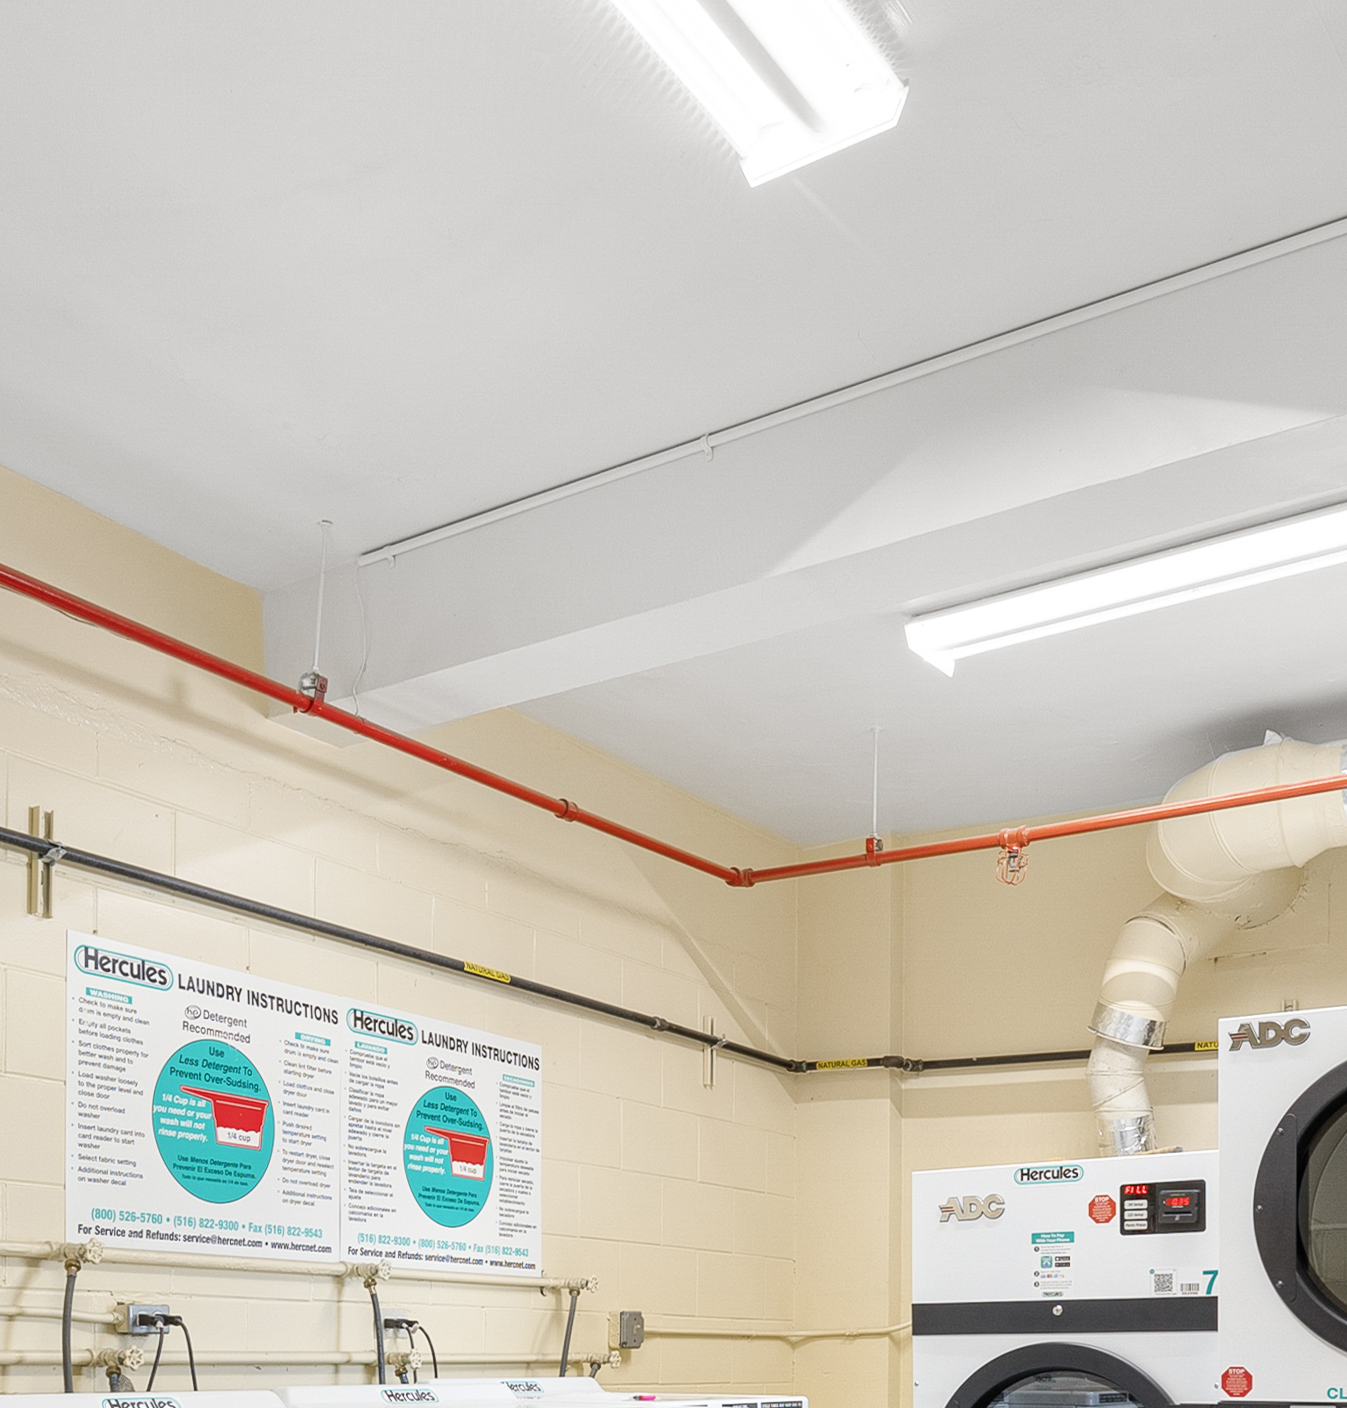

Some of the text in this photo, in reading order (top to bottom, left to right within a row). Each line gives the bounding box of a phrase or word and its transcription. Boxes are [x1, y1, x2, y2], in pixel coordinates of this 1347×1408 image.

[84, 946, 339, 1025] Hercules LAUNDRY INSTRUCTIONS
[88, 989, 130, 1004] WASHING
[203, 1009, 247, 1028] Detergent
[182, 1020, 251, 1044] Recommended
[353, 1010, 540, 1071] Hercules LAUNDRY INSTRUCTIONS
[1228, 1017, 1311, 1051] ADC
[209, 1046, 224, 1058] Use
[179, 1055, 252, 1076] Less Detergent To
[440, 1060, 472, 1076] Detergent
[170, 1067, 261, 1092] Prevent Over-Sudsing.
[425, 1069, 475, 1089] Recommended
[227, 1131, 251, 1142] 1/4 cup
[1020, 1166, 1079, 1182] Hercules
[1124, 1185, 1148, 1195] FILL
[939, 1193, 1005, 1222] ADC
[91, 1208, 323, 1238] (800) 526-5760 (516) 822-9300 Fax (516) 822-9543
[77, 1224, 332, 1253] For Service and Refunds: service@hercnet.com www.hercnet.com
[1202, 1269, 1219, 1295] 7
[384, 1389, 435, 1403] Hercules
